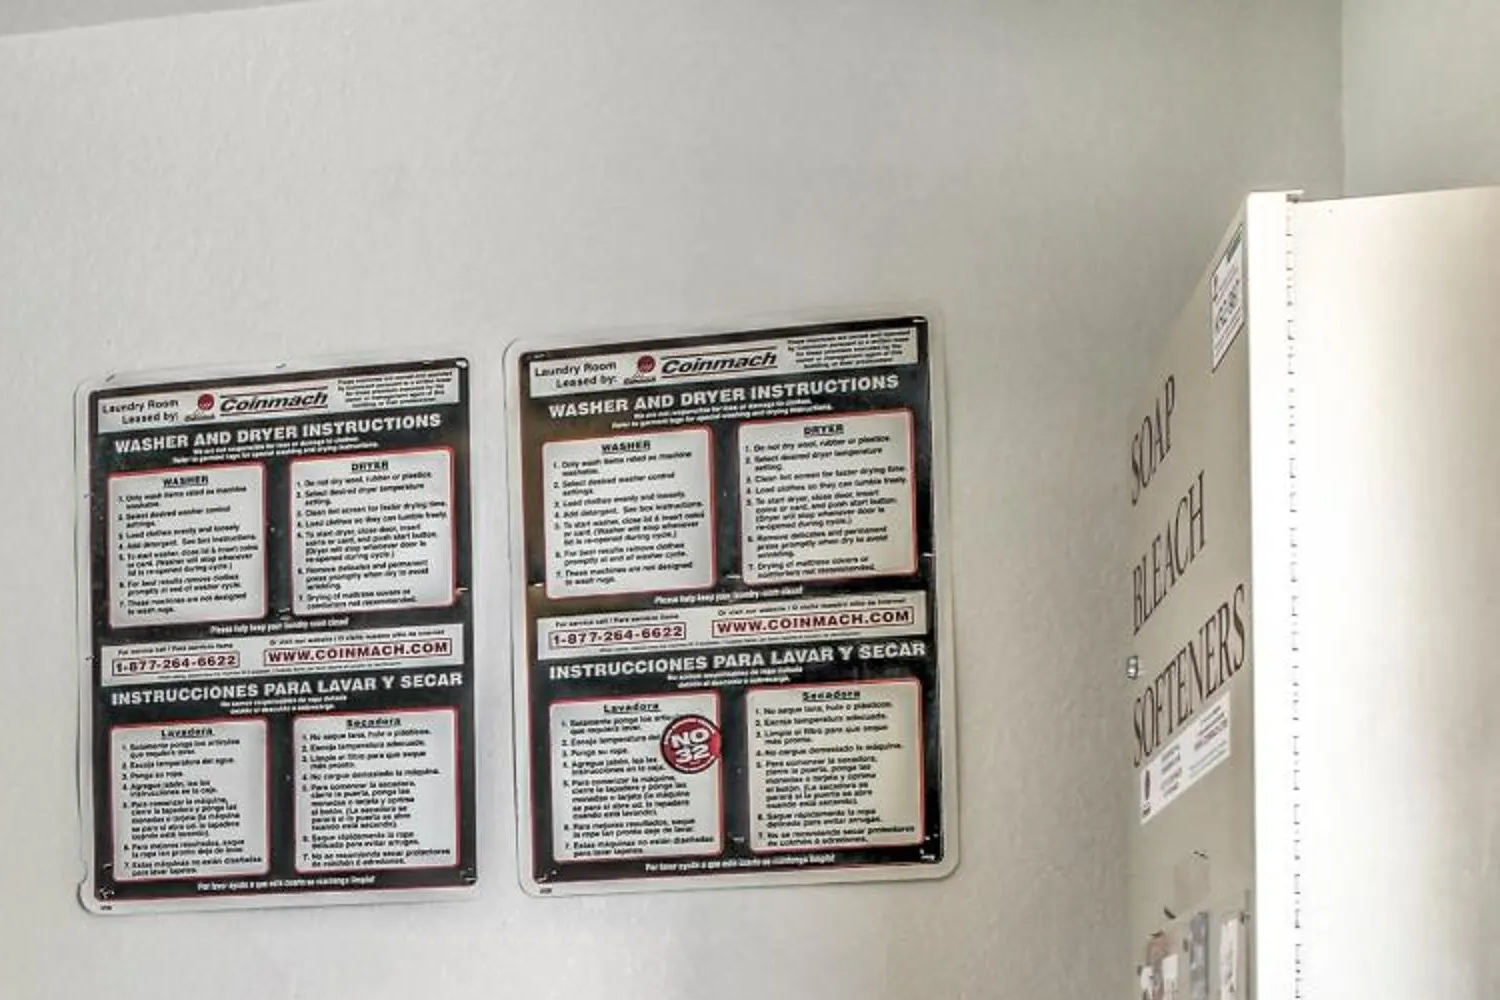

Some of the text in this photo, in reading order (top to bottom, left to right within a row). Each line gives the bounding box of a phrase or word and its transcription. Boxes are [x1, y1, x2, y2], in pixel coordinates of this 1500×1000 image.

[535, 361, 617, 377] Laundry Room
[661, 351, 777, 375] Coinmach
[556, 376, 597, 388] Leased
[600, 375, 618, 386] by:
[102, 400, 179, 413] Laundry Room
[220, 391, 328, 412] Coinmach
[549, 399, 628, 419] WASHER
[634, 395, 674, 411] AND
[680, 387, 745, 406] DRYER
[750, 374, 899, 400] INSTRUCTIONS
[122, 413, 158, 424] Leased
[115, 436, 188, 453] WASHER
[194, 432, 231, 447] AND
[237, 424, 297, 442] DRYER
[302, 412, 441, 437] INSTRUCTIONS
[804, 424, 844, 435] DRYER
[602, 440, 651, 451] WASHER
[1132, 374, 1176, 506] SOAP
[351, 460, 389, 471] DRYER
[163, 475, 208, 486] WASHER
[1133, 469, 1205, 637] BLEACH
[717, 611, 909, 633] WWW.COINMACH.COM
[553, 626, 682, 646] 1-877-264-6622
[268, 641, 448, 662] WWW.COINMACH.COM
[549, 655, 707, 680] INSTRUCCIONES
[713, 652, 765, 670] PARA
[770, 649, 833, 667] LAVAR
[837, 647, 854, 661] Y
[857, 642, 926, 660] SECAR
[115, 655, 236, 673] 1-877-264-6622
[1133, 584, 1246, 769] SOFTENERS
[111, 684, 258, 706] INSTRUCCIONES
[264, 681, 312, 697] PARA
[317, 677, 376, 693] LAVAR
[381, 676, 395, 689] Y
[400, 672, 463, 689] SECAR
[603, 702, 659, 713] Lavadora
[671, 728, 710, 748] NO
[675, 744, 710, 763] 32
